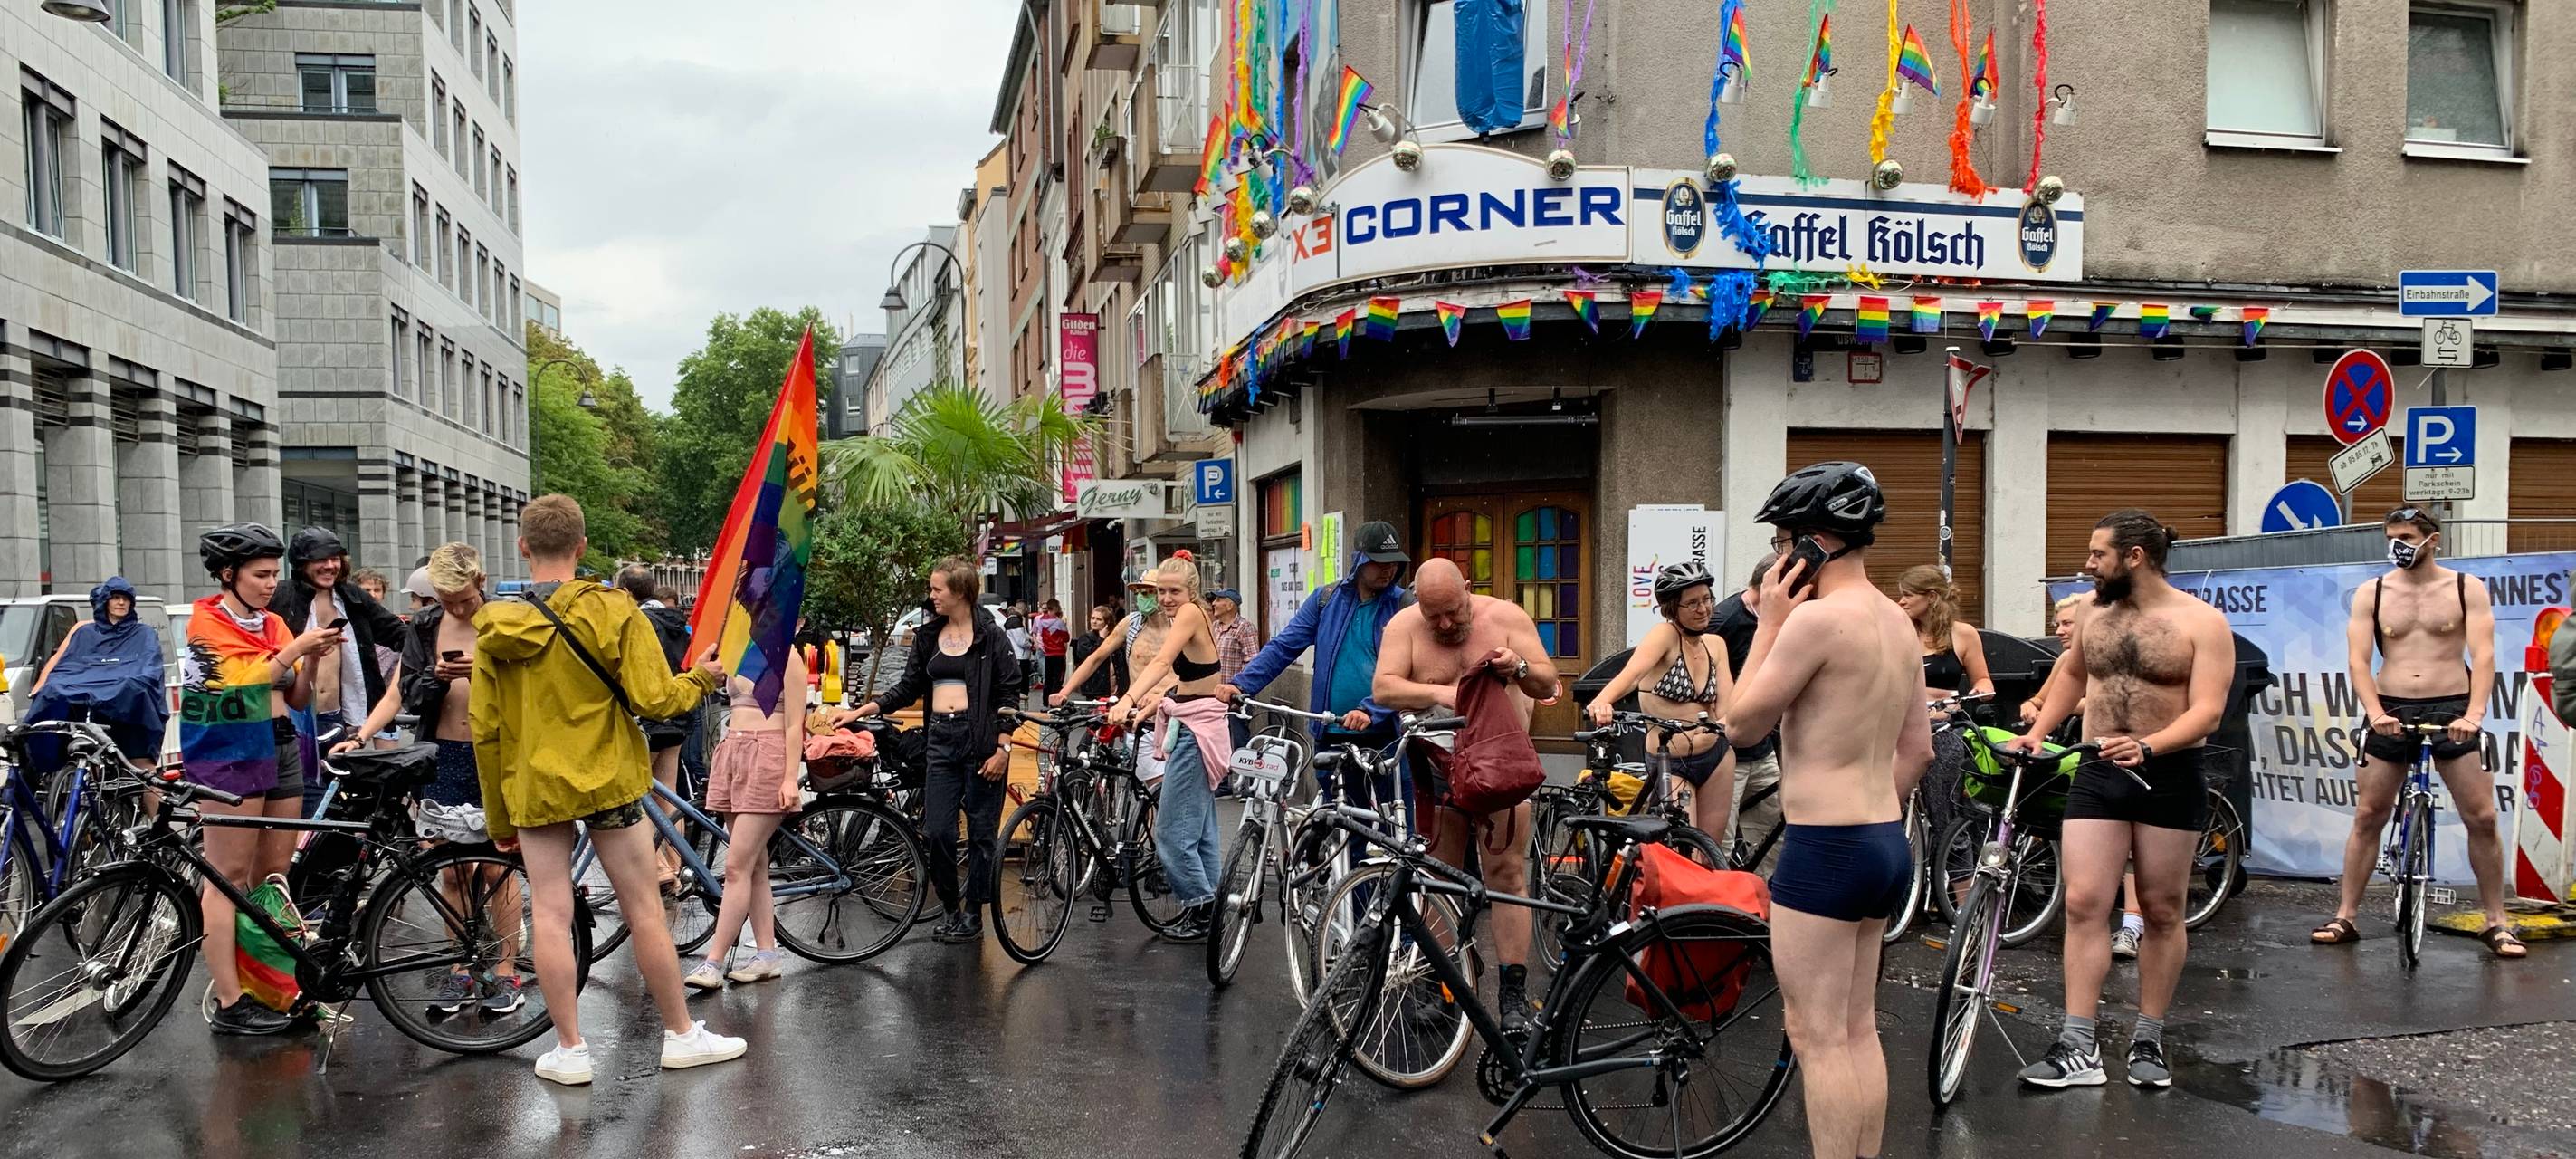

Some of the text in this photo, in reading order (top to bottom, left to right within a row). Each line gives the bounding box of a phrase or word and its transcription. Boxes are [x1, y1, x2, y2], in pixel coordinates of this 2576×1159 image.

[1347, 187, 1626, 245] CORNER
[1666, 209, 1702, 227] Gaffel
[1673, 225, 1695, 236] Kölsch
[2021, 226, 2054, 243] Gaffel
[1867, 216, 1985, 271] Kölsch
[2406, 289, 2470, 300] Einbahnstraße
[1063, 319, 1095, 330] Gilden
[1064, 340, 1086, 360] die
[2417, 415, 2455, 464] P
[1204, 465, 1224, 499] P
[2409, 489, 2445, 497] werktags
[1633, 553, 1658, 608] LOVE
[1239, 757, 1255, 767] KVB
